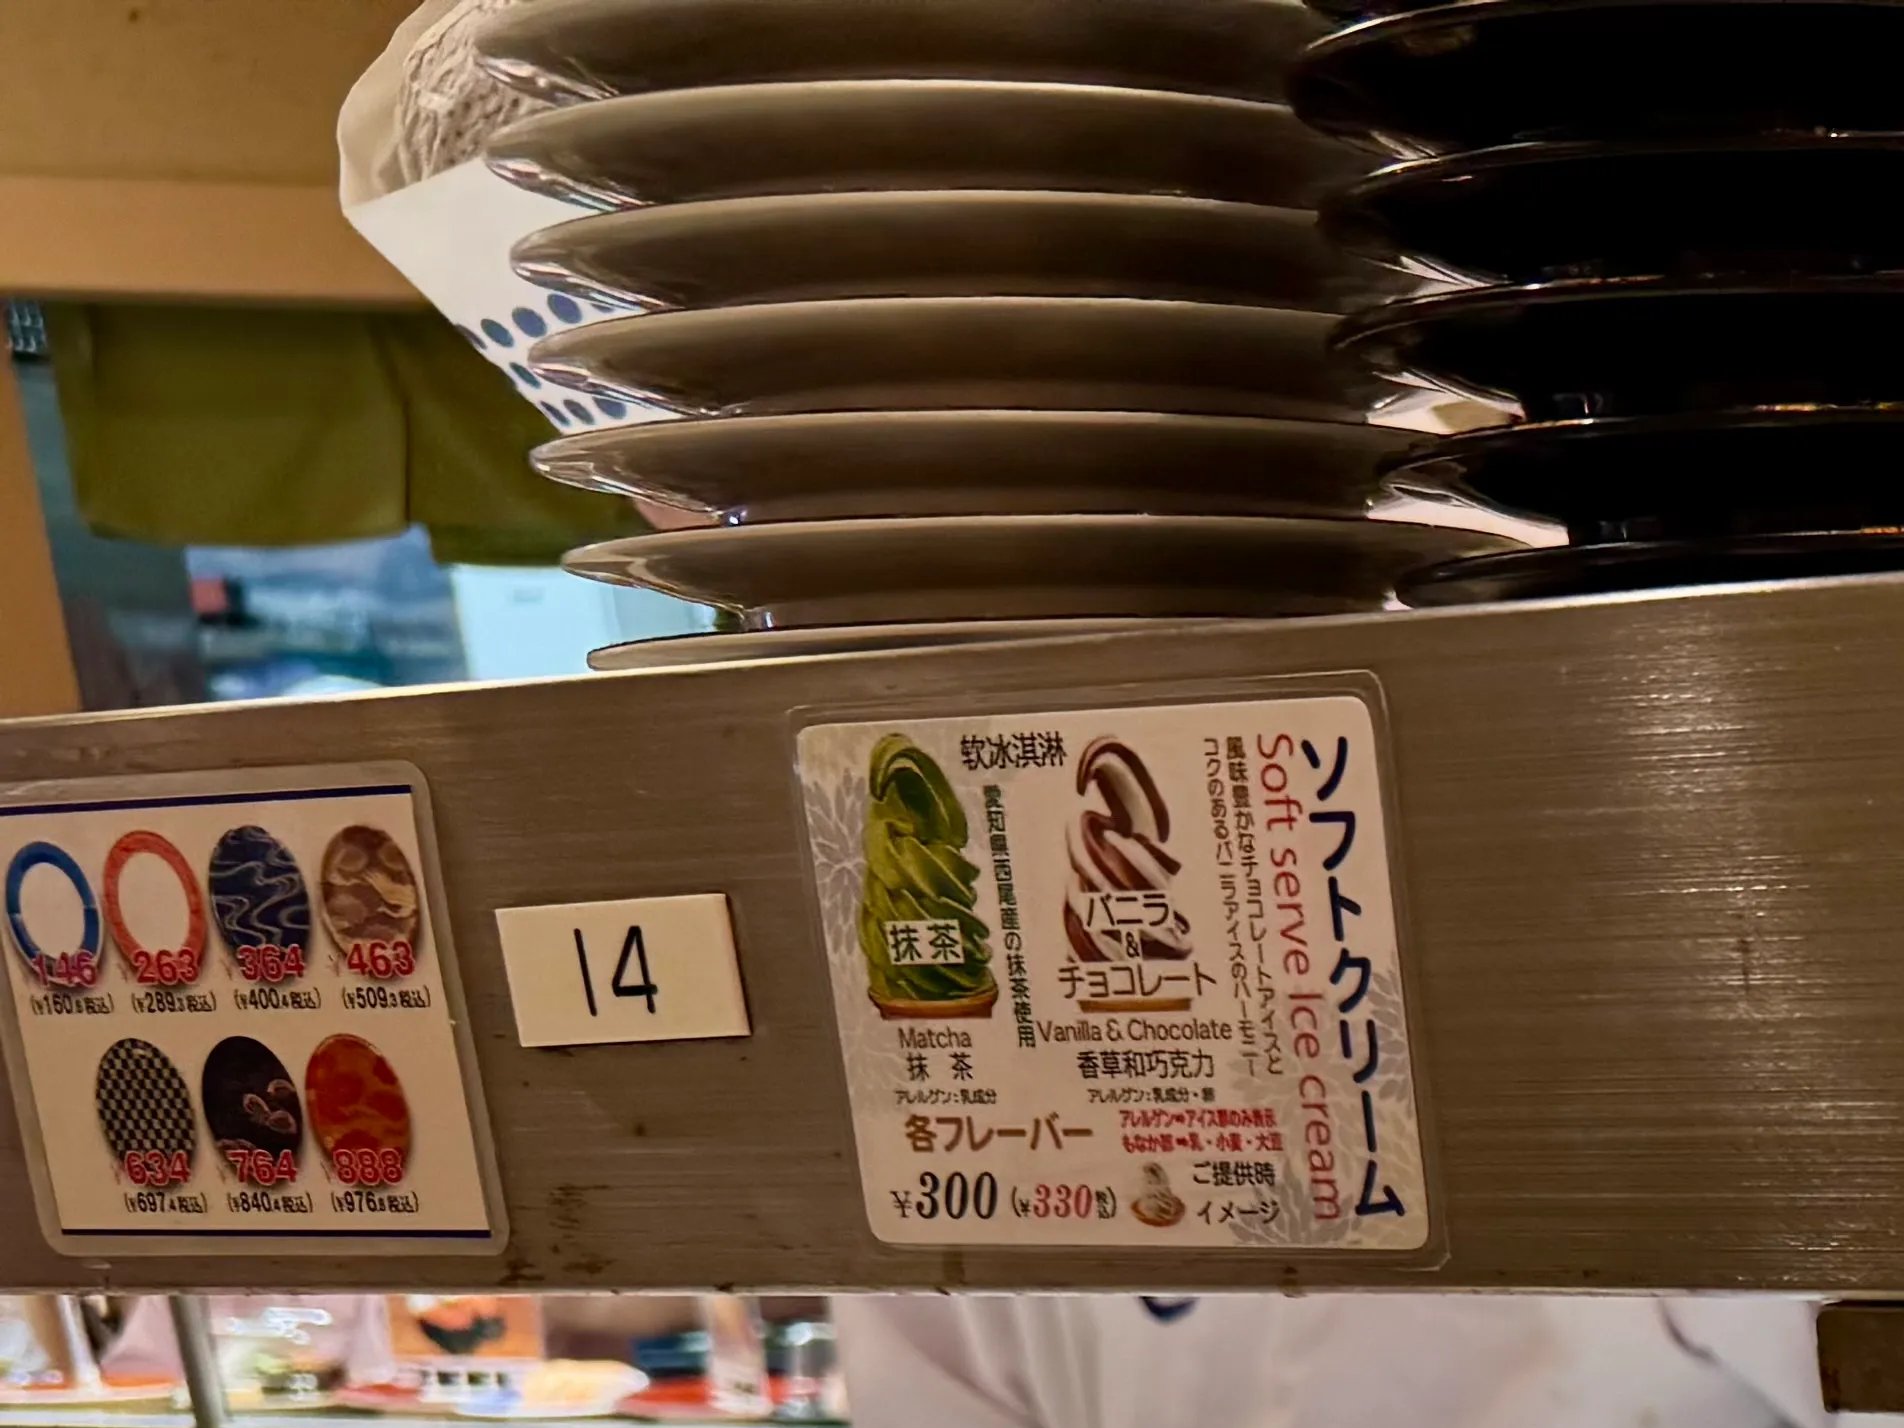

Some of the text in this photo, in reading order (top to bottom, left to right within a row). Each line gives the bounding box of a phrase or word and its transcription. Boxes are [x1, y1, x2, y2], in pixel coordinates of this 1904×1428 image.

[960, 732, 1066, 769] 软冰淇淋
[1085, 894, 1170, 926] バニラ
[889, 924, 962, 963] 抹茶
[1124, 932, 1141, 958] &
[572, 924, 659, 1019] 14
[1058, 962, 1216, 999] チョコレート
[1255, 733, 1343, 1222] Soft serve cream
[1301, 737, 1404, 1217] ソフトクリーム
[898, 1027, 972, 1048] Matcha
[1036, 1019, 1232, 1045] Vanilla Chocolate
[1077, 1051, 1215, 1079] 香草和巧克力
[905, 1114, 1093, 1153] 各フレーバー
[1193, 1162, 1276, 1187] ご提供時
[890, 1171, 998, 1219] ¥300
[1197, 1199, 1280, 1226] イメージ
